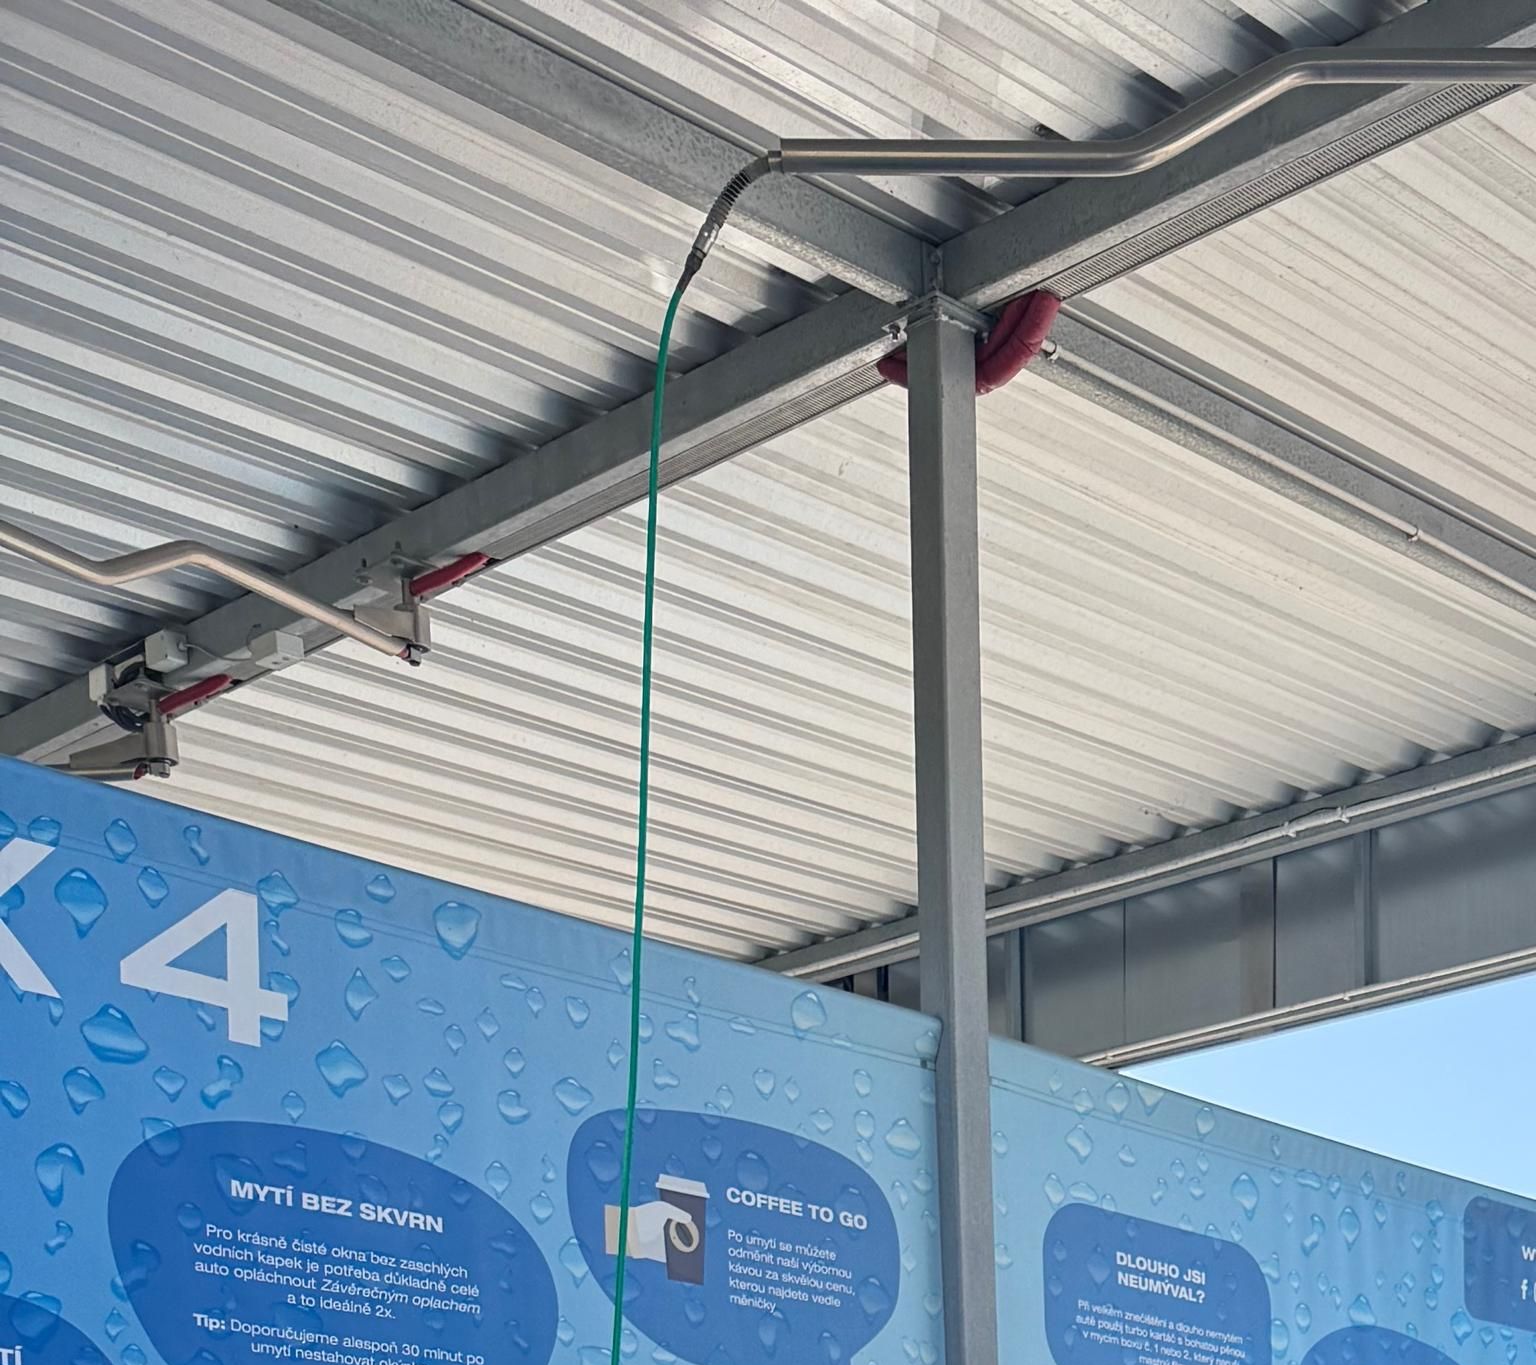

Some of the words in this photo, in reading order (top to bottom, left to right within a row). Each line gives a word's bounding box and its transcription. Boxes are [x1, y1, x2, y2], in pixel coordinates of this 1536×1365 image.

[120, 888, 288, 1047] 4
[230, 1179, 293, 1207] MYTÍ
[301, 1191, 352, 1217] BEZ
[359, 1203, 443, 1233] SKVRN
[726, 1187, 803, 1217] COFFEE
[807, 1203, 833, 1223] TO
[839, 1211, 867, 1230] GO
[206, 1224, 233, 1241] Pro
[237, 1231, 287, 1250] krásně
[292, 1239, 326, 1256] čisté
[332, 1247, 366, 1263] okna
[370, 1252, 396, 1268] bez
[400, 1256, 468, 1280] zaschlých
[728, 1229, 743, 1242] Po
[746, 1234, 776, 1250] umytí
[779, 1242, 792, 1251] se
[795, 1243, 836, 1261] můžete
[194, 1241, 253, 1262] vodních
[258, 1251, 303, 1272] kapek
[306, 1260, 319, 1273] je
[324, 1262, 380, 1283] potřeba
[384, 1270, 446, 1293] důkladně
[450, 1282, 480, 1297] celé
[728, 1248, 774, 1265] odměnit
[802, 1258, 852, 1279] výbornou
[729, 1261, 762, 1278] kávou
[765, 1270, 779, 1281] za
[782, 1271, 823, 1288] skvělou
[826, 1280, 855, 1296] cenu,
[1116, 1251, 1179, 1278] DLOUHO
[1184, 1269, 1206, 1285] JSI
[194, 1260, 229, 1276] auto
[234, 1266, 316, 1290] opláchnout
[320, 1278, 408, 1304] Závěrečným
[729, 1279, 765, 1294] kterou
[769, 1284, 809, 1301] najdete
[812, 1291, 841, 1307] vedle
[1118, 1271, 1205, 1303] NEUMÝVAL?
[287, 1294, 296, 1304] a
[300, 1295, 315, 1308] to
[375, 1305, 396, 1319] 2x.
[193, 1313, 226, 1332] Tip:
[230, 1319, 338, 1346] Doporučujeme
[343, 1337, 398, 1355] alespoň
[401, 1343, 420, 1357] 30
[423, 1347, 463, 1363] minut
[251, 1342, 291, 1359] umytí
